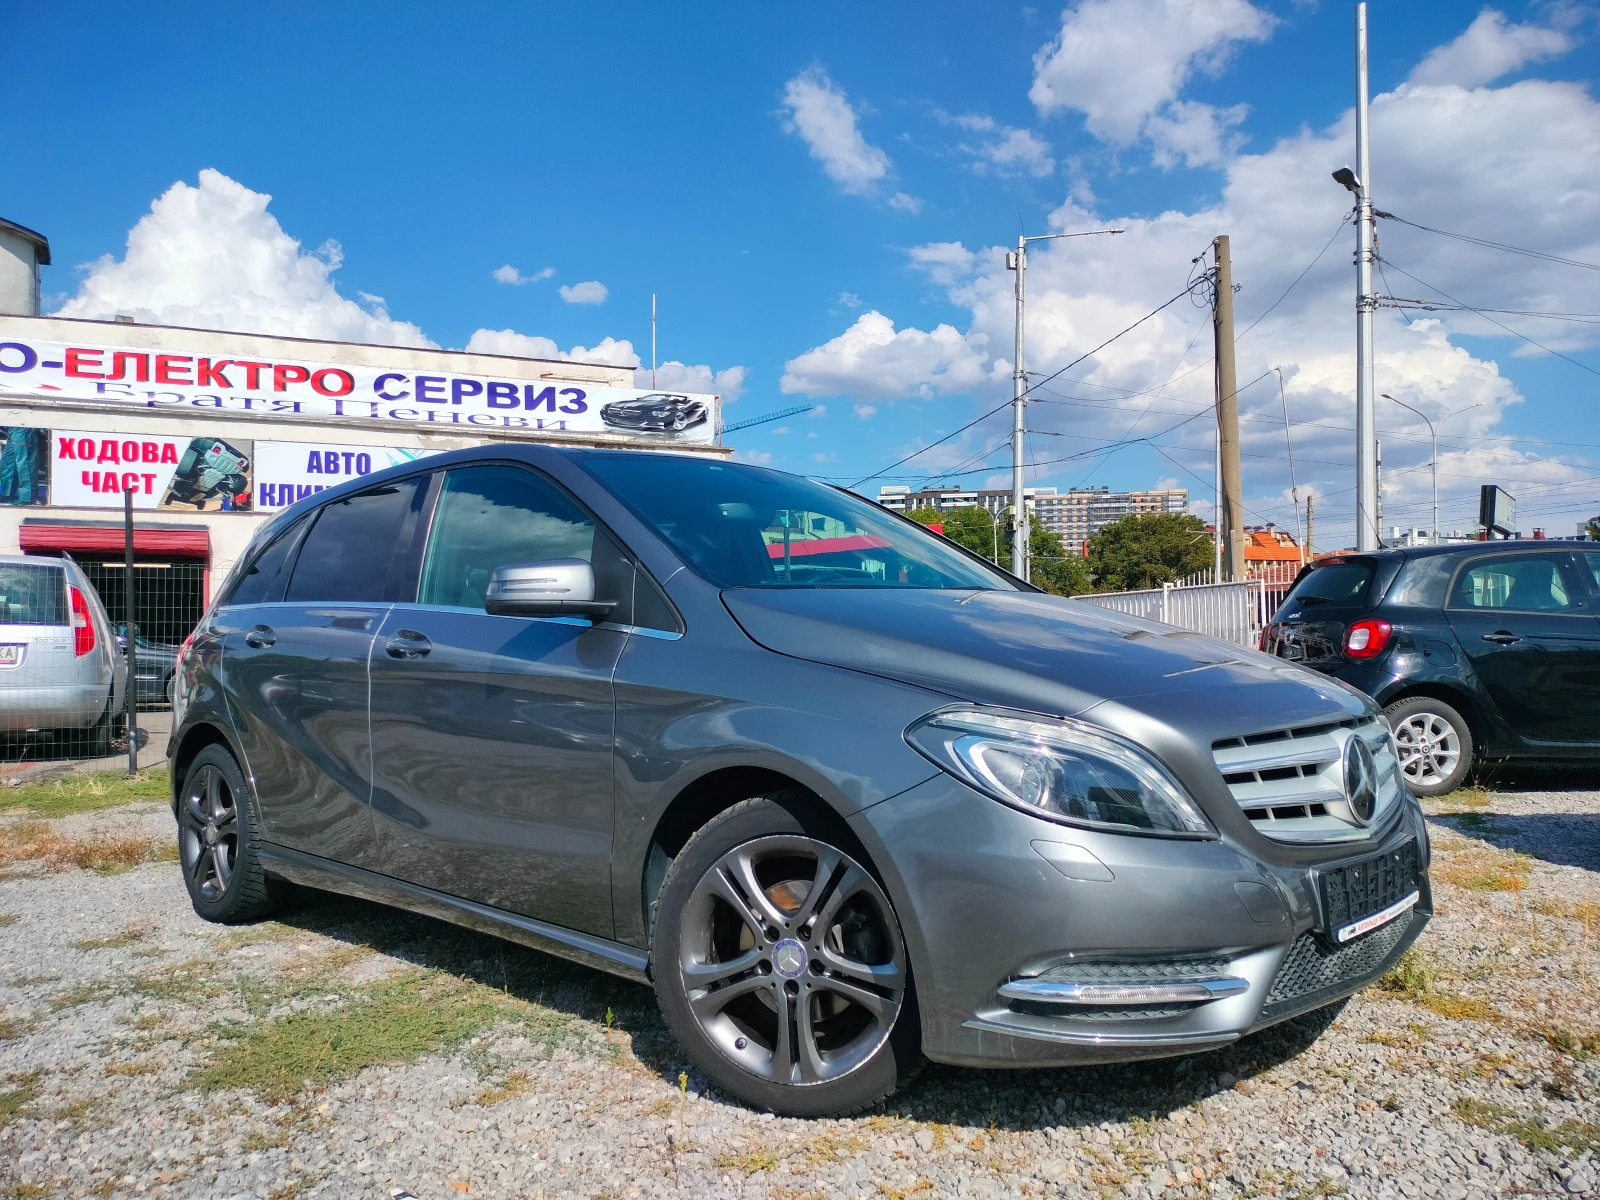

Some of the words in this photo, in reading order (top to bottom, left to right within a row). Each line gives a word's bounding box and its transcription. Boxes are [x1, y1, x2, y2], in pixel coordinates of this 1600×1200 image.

[89, 381, 306, 413] Братя
[328, 399, 572, 431] Пеневи
[373, 372, 588, 414] СЕРВИЗ
[58, 437, 179, 465] ХОДОВА
[306, 450, 372, 476] АВТО
[81, 471, 157, 495] ЧАСТ
